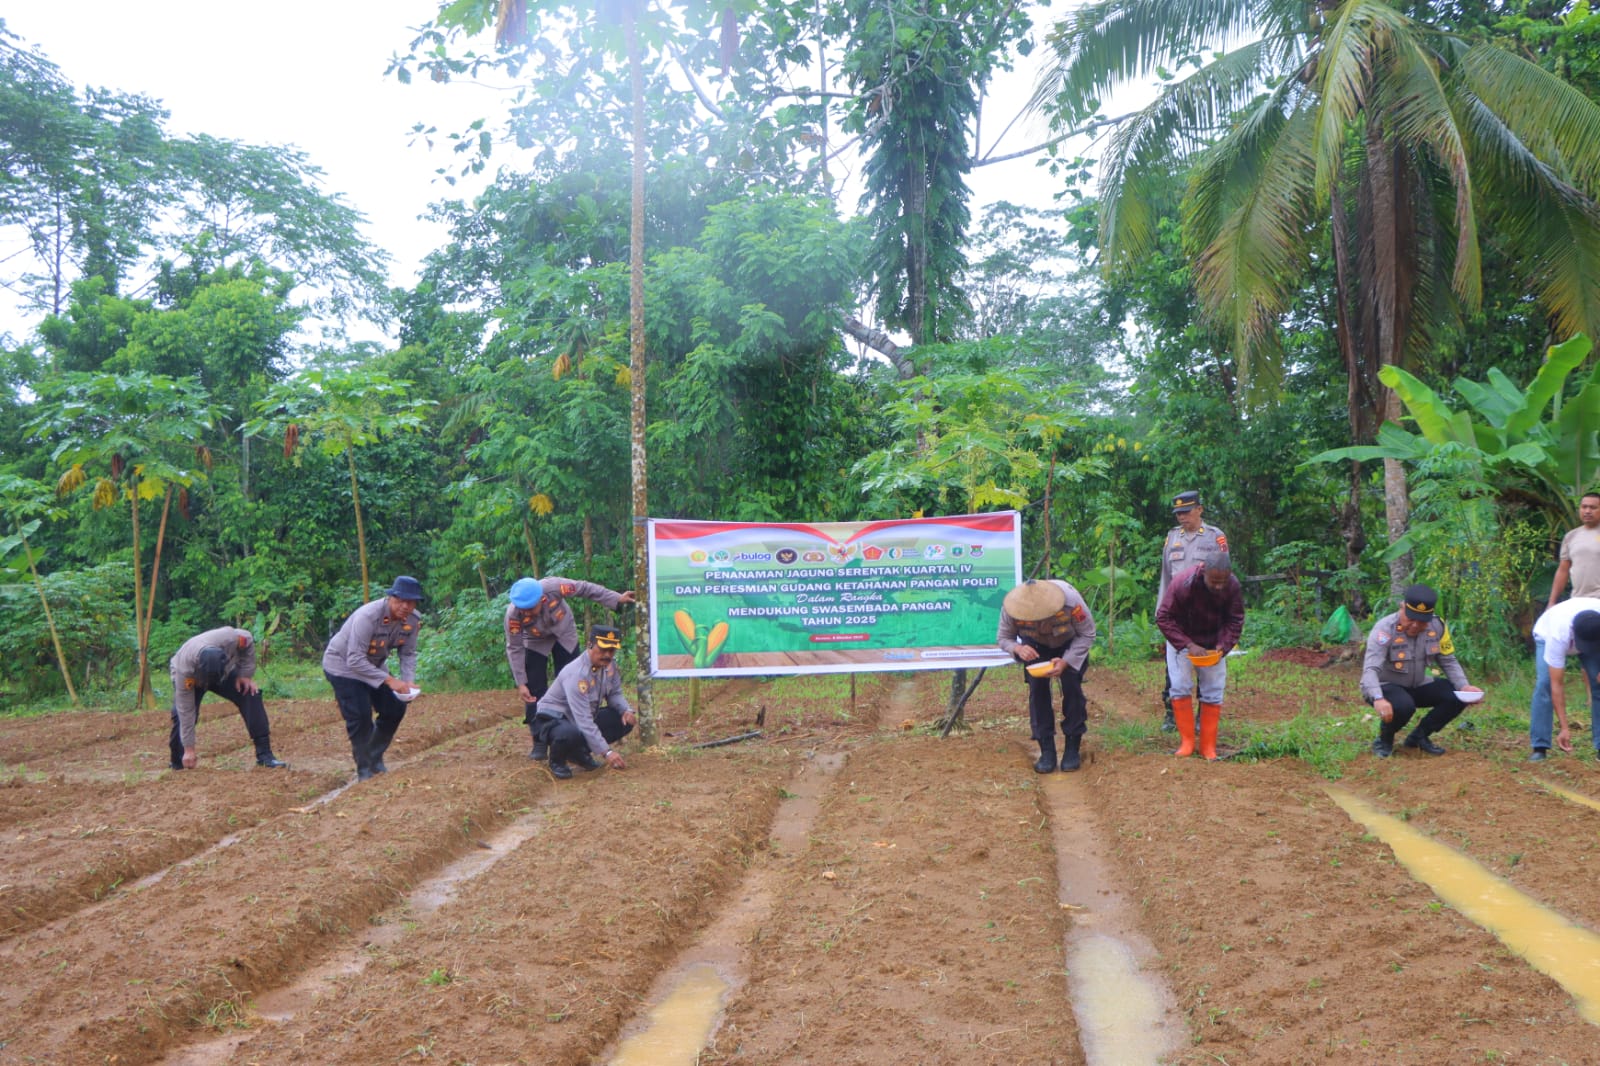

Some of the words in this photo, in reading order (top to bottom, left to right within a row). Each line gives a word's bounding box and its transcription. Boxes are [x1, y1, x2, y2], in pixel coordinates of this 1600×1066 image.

[705, 570, 784, 579] PENANAMAN
[786, 568, 834, 578] JAGUNG
[838, 567, 900, 576] SERENTAK
[903, 565, 957, 574] KUARTAL
[960, 564, 972, 573] IV
[675, 585, 700, 594] DAN
[704, 584, 777, 594] PERESMIAN
[781, 583, 831, 592] GUDANG
[835, 581, 907, 590] KETAHANAN
[910, 579, 959, 588] PANGAN
[963, 577, 998, 587] POLRI
[796, 593, 835, 603] Dalam
[840, 592, 883, 604] Rangka
[728, 606, 808, 616] MENDUKUNG
[811, 603, 898, 614] SWASEMBADA
[902, 602, 951, 611] PANGAN
[802, 617, 842, 626] TAHUN
[845, 616, 877, 625] 2025
